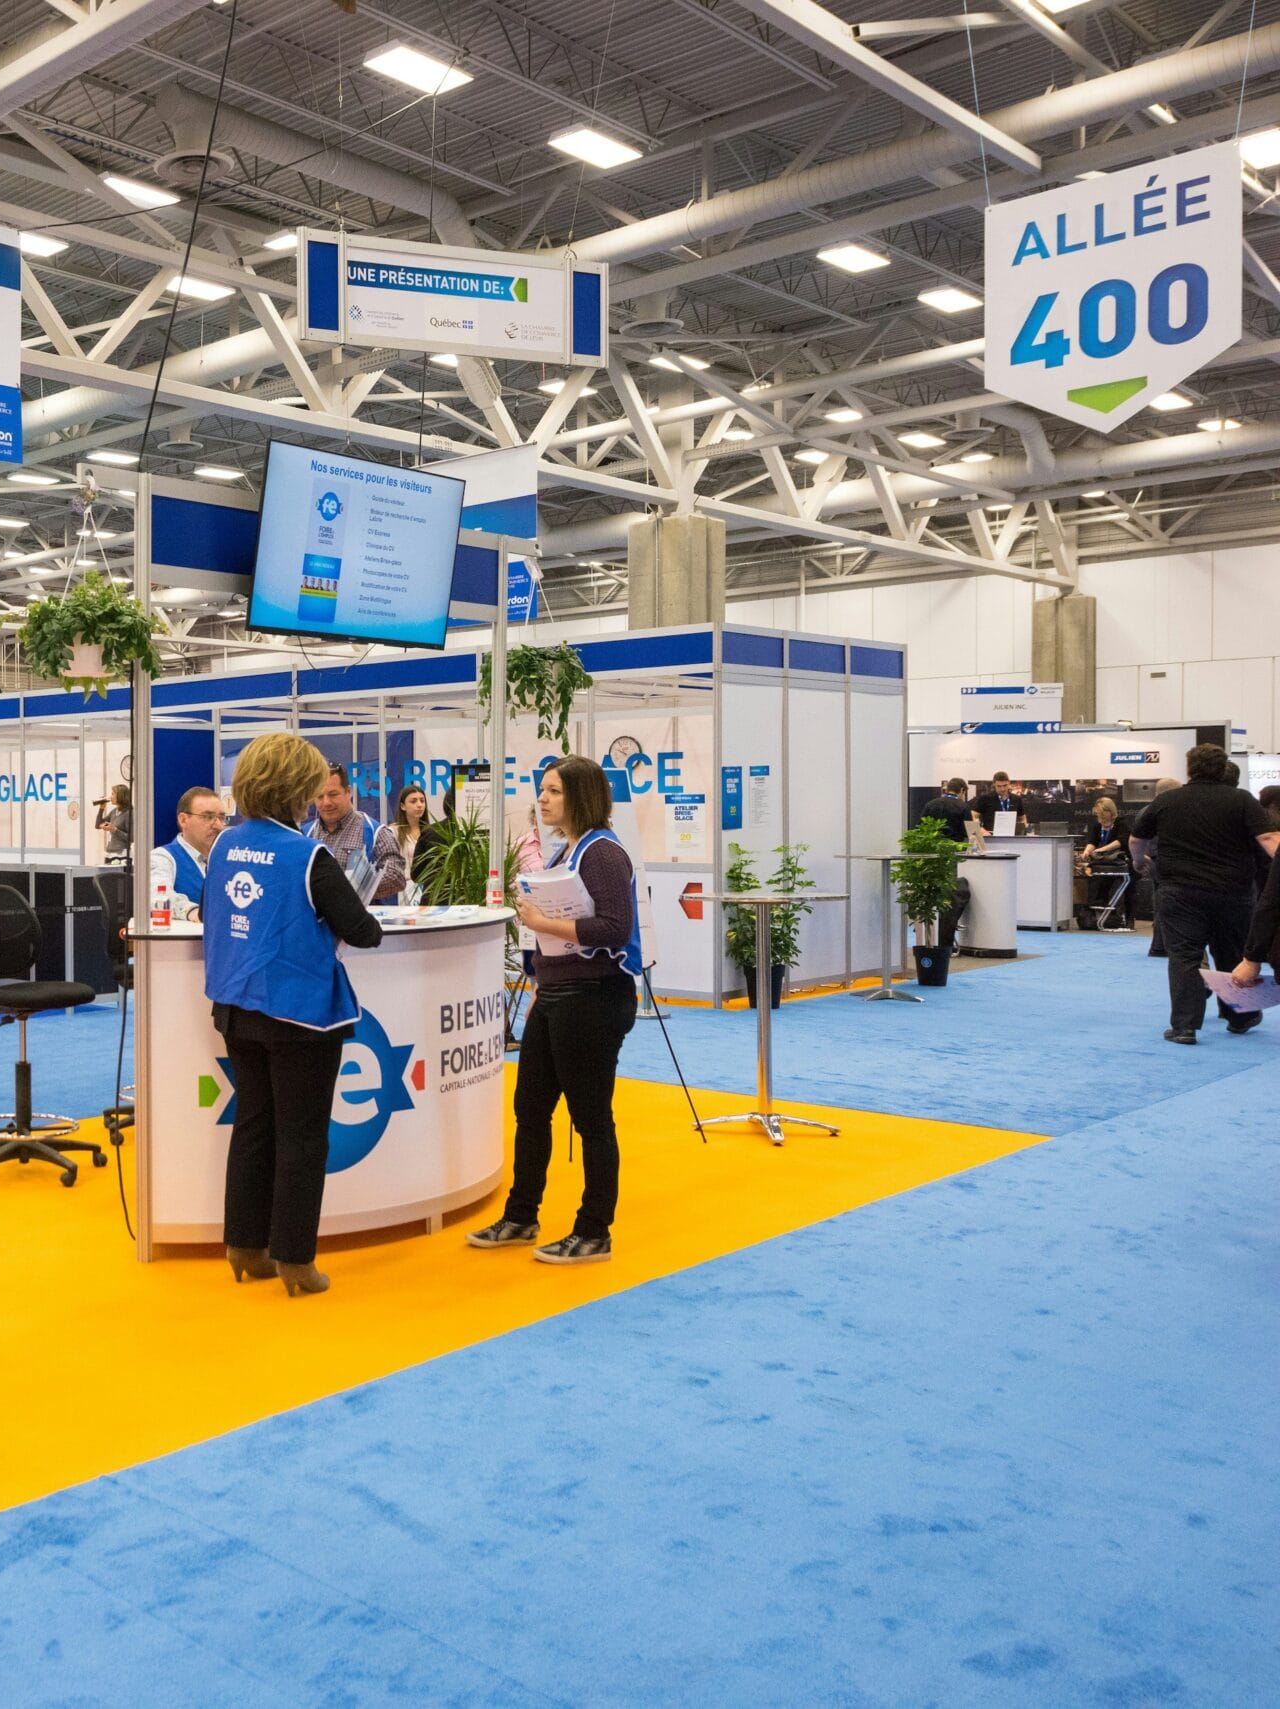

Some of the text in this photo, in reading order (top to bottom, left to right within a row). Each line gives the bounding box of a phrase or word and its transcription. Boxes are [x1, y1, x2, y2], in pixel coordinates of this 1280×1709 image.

[1011, 174, 1210, 266] ALLÉE
[347, 265, 504, 295] UNE PRÉSENTATION DE:
[429, 316, 462, 329] Québec
[1010, 262, 1209, 369] 400
[311, 460, 433, 494] Nos services pour les visiteurs
[322, 498, 338, 514] fe
[226, 846, 276, 865] BÉNÉVOLE
[233, 880, 252, 899] fe
[440, 1041, 484, 1077] FOIRE
